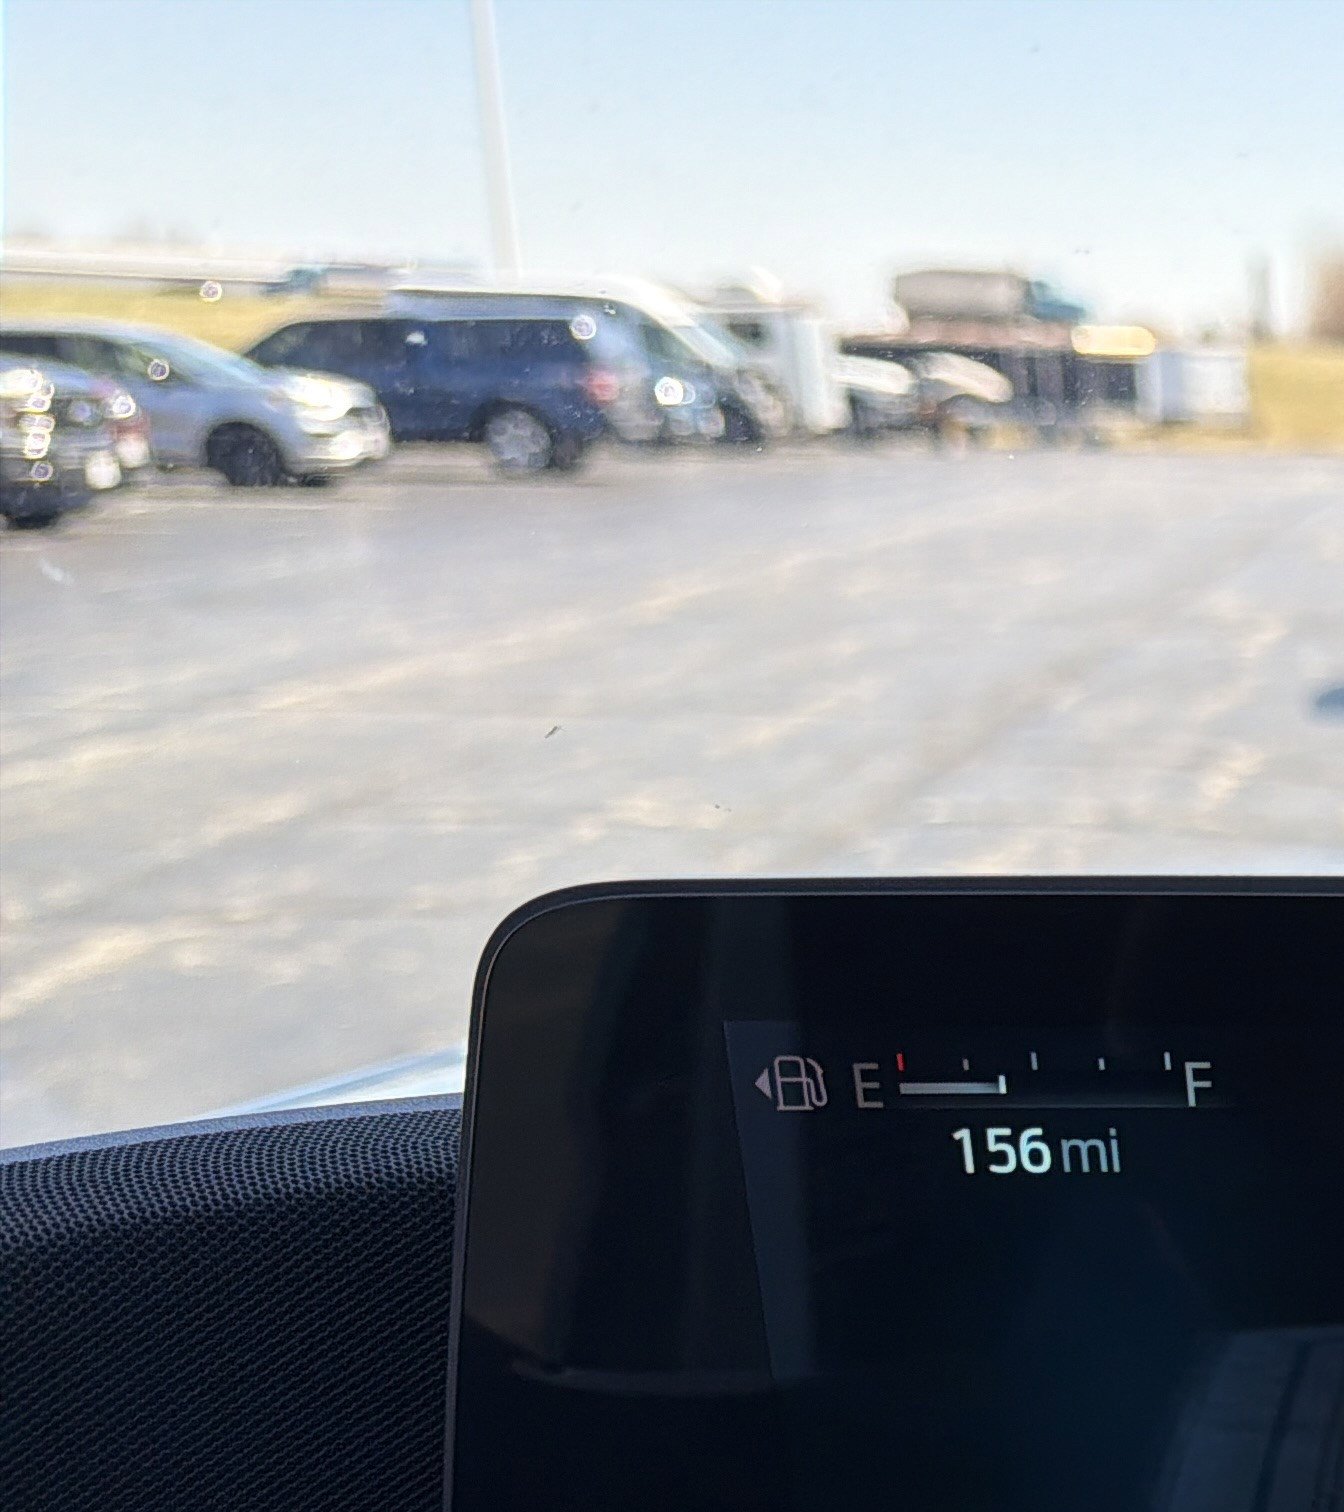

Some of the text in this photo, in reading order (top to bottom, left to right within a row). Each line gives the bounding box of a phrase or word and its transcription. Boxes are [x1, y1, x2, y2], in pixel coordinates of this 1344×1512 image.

[854, 1062, 884, 1108] E
[1184, 1061, 1213, 1107] F
[952, 1128, 1121, 1174] 156 mi
